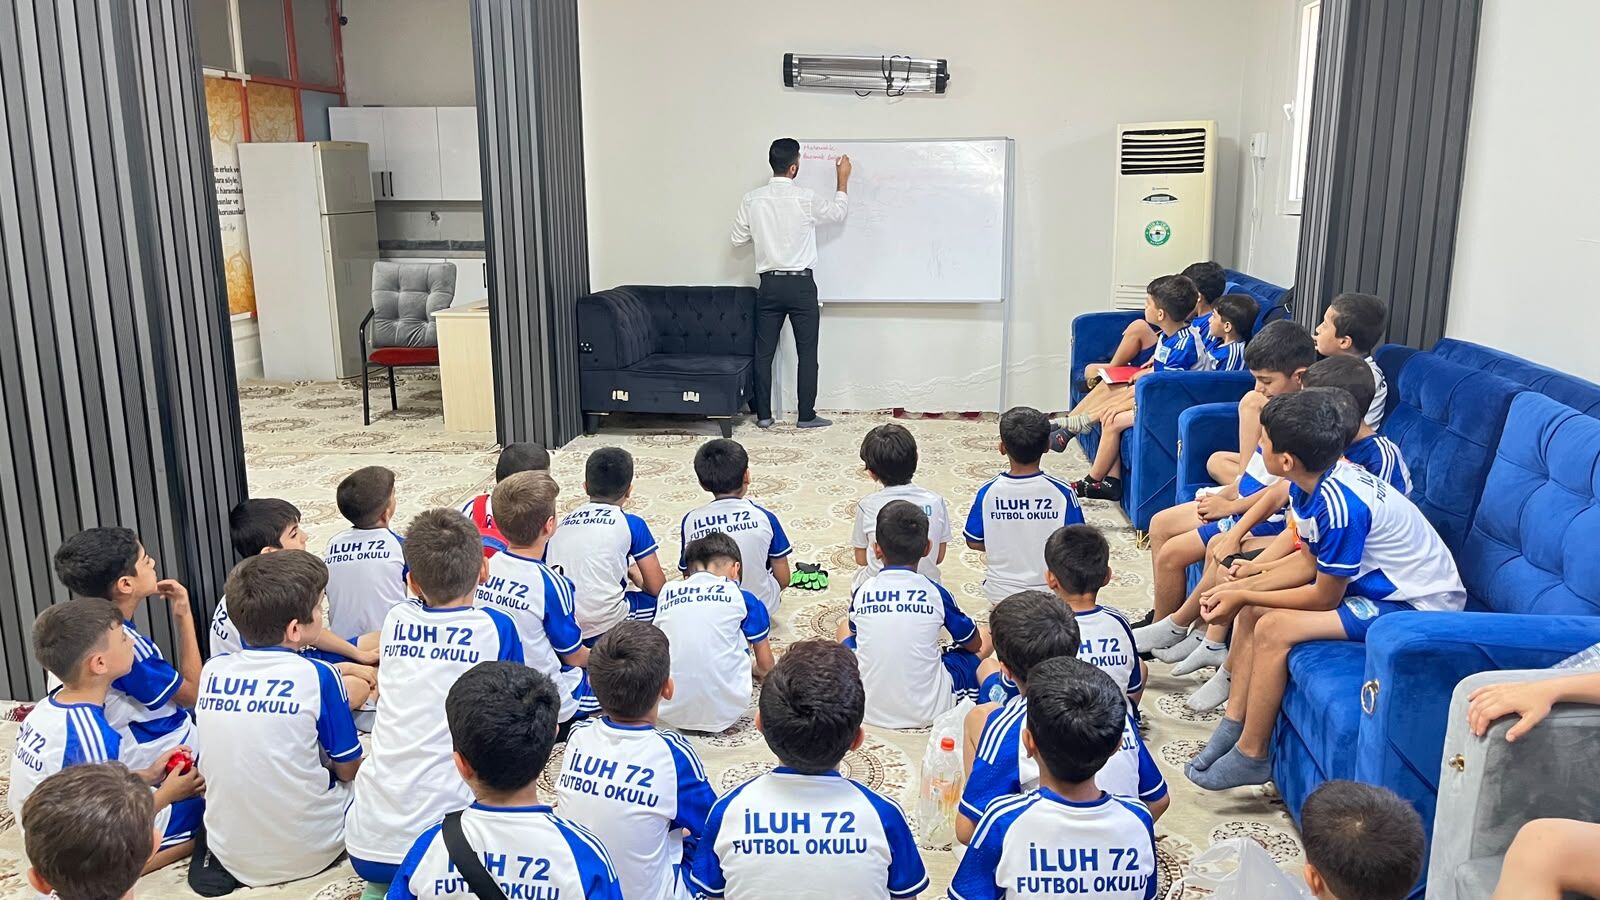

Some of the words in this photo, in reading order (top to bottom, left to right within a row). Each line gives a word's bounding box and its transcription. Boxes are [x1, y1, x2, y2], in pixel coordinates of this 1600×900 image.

[995, 496, 1030, 511] İLUH
[1034, 498, 1053, 510] 72
[595, 508, 612, 517] 72
[732, 510, 751, 522] 72
[990, 511, 1026, 520] FUTBOL
[1026, 511, 1059, 520] OKULU
[582, 517, 617, 526] OKULU
[726, 521, 759, 533] OKULU
[367, 539, 387, 551] 72
[357, 551, 391, 560] OKULU
[507, 580, 530, 599] 72
[706, 584, 726, 595] 72
[906, 589, 928, 602] 72
[495, 594, 530, 611] OKULU
[659, 595, 694, 613] FUTBOL
[696, 594, 732, 603] OKULU
[855, 604, 893, 616] FUTBOL
[896, 603, 935, 615] OKULU
[215, 603, 228, 626] 72
[392, 619, 438, 644] İLUH
[445, 626, 474, 647] 72
[1097, 637, 1121, 653] 72
[383, 644, 426, 659] FUTBOL
[430, 647, 481, 664] OKULU
[1090, 655, 1128, 667] OKULU
[205, 672, 259, 697] İLUH
[265, 679, 295, 698] 72
[198, 697, 242, 713] FUTBOL
[246, 699, 300, 715] OKULU
[28, 732, 46, 754] 72
[17, 747, 43, 772] OKULU
[569, 748, 619, 780] İLUH
[624, 764, 656, 789] 72
[559, 773, 600, 797] FUTBOL
[603, 783, 659, 808] OKULU
[744, 808, 811, 835] İLUH
[821, 811, 856, 835] 72
[732, 838, 801, 855] FUTBOL
[805, 838, 868, 855] OKULU
[1028, 842, 1099, 872] İLUH
[1108, 847, 1140, 872] 72
[516, 855, 551, 881] 72
[1016, 876, 1089, 894] FUTBOL
[1093, 874, 1149, 893] OKULU
